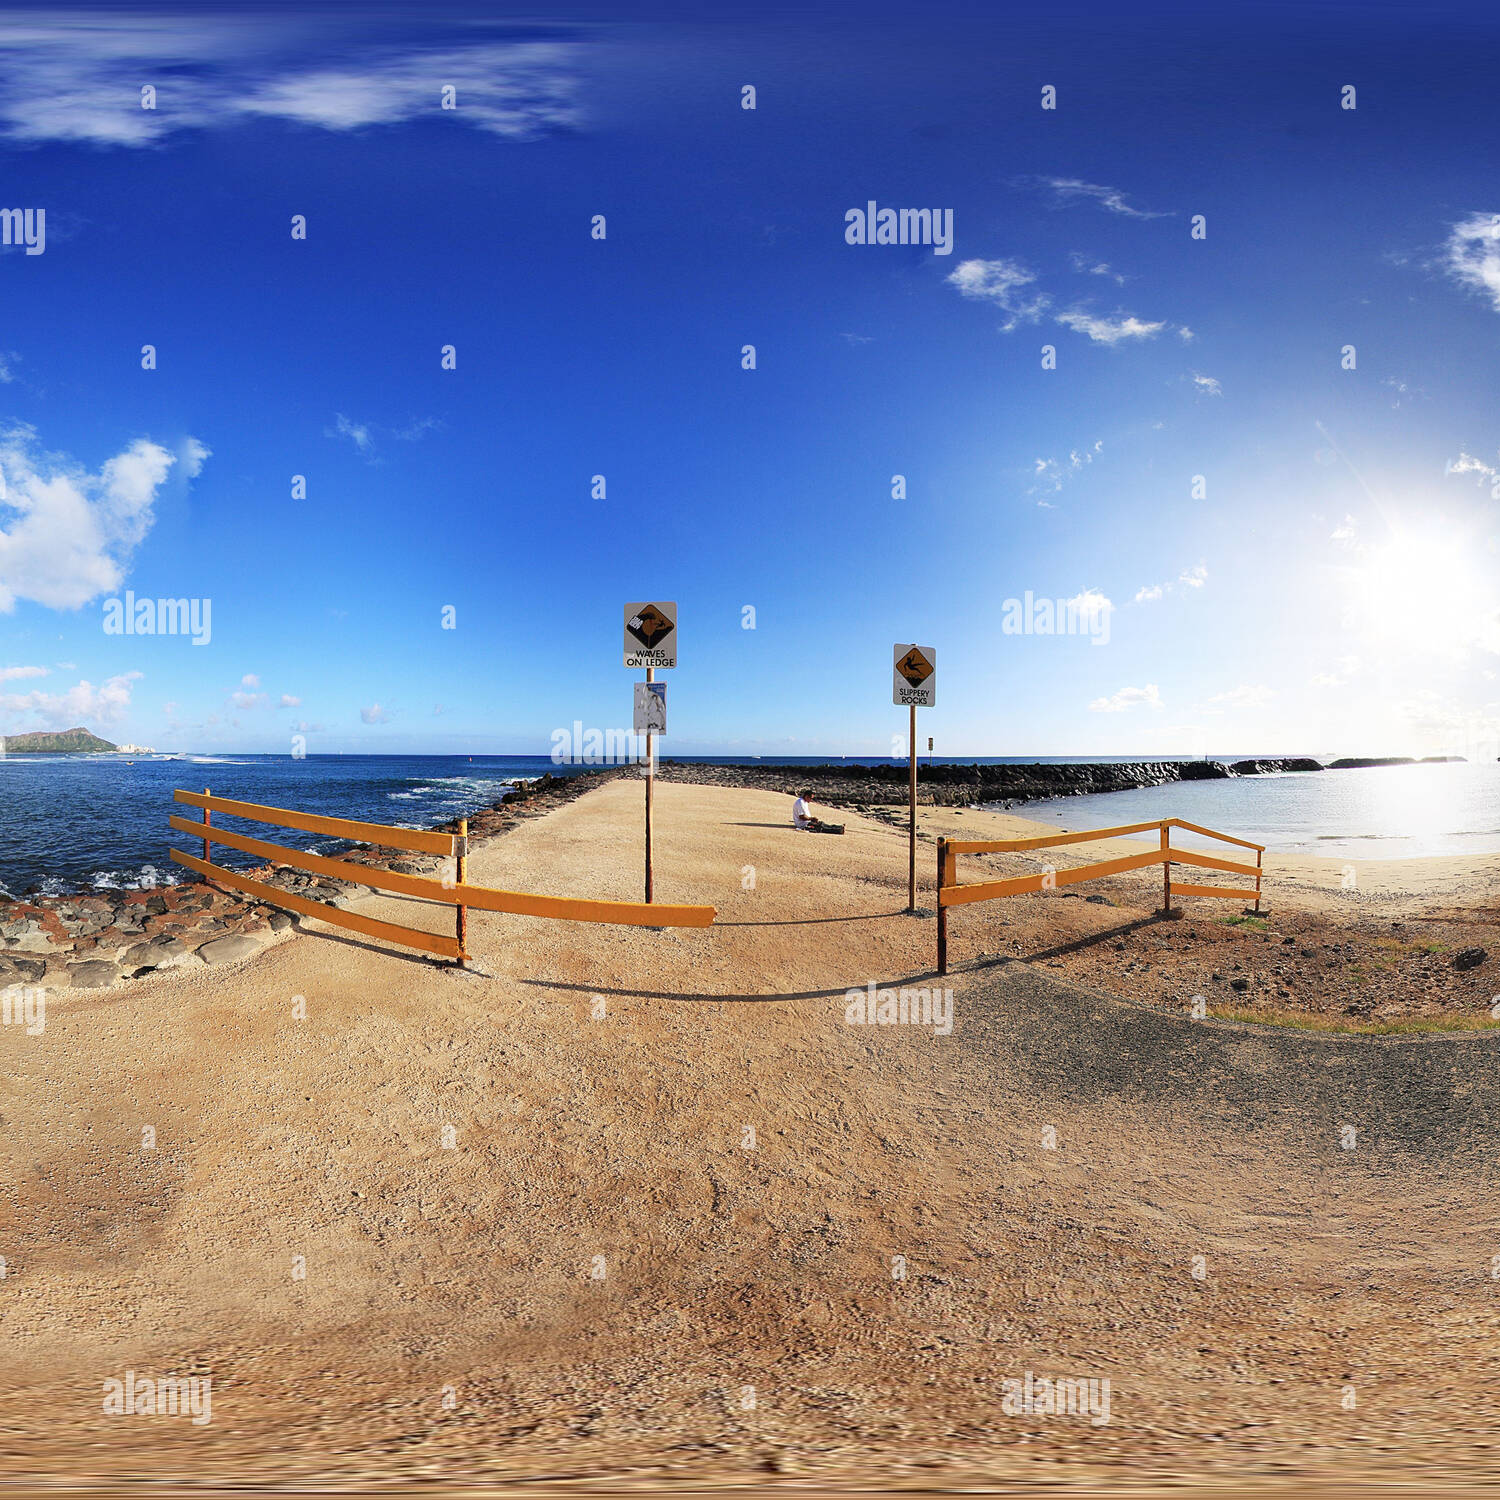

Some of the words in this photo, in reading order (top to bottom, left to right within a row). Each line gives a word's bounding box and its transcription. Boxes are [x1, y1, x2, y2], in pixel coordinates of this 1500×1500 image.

[636, 650, 665, 658] WAVES
[627, 659, 642, 667] ON
[646, 659, 674, 667] LEDGE
[899, 688, 930, 698] SLIPPERY
[901, 697, 928, 705] ROCKS
